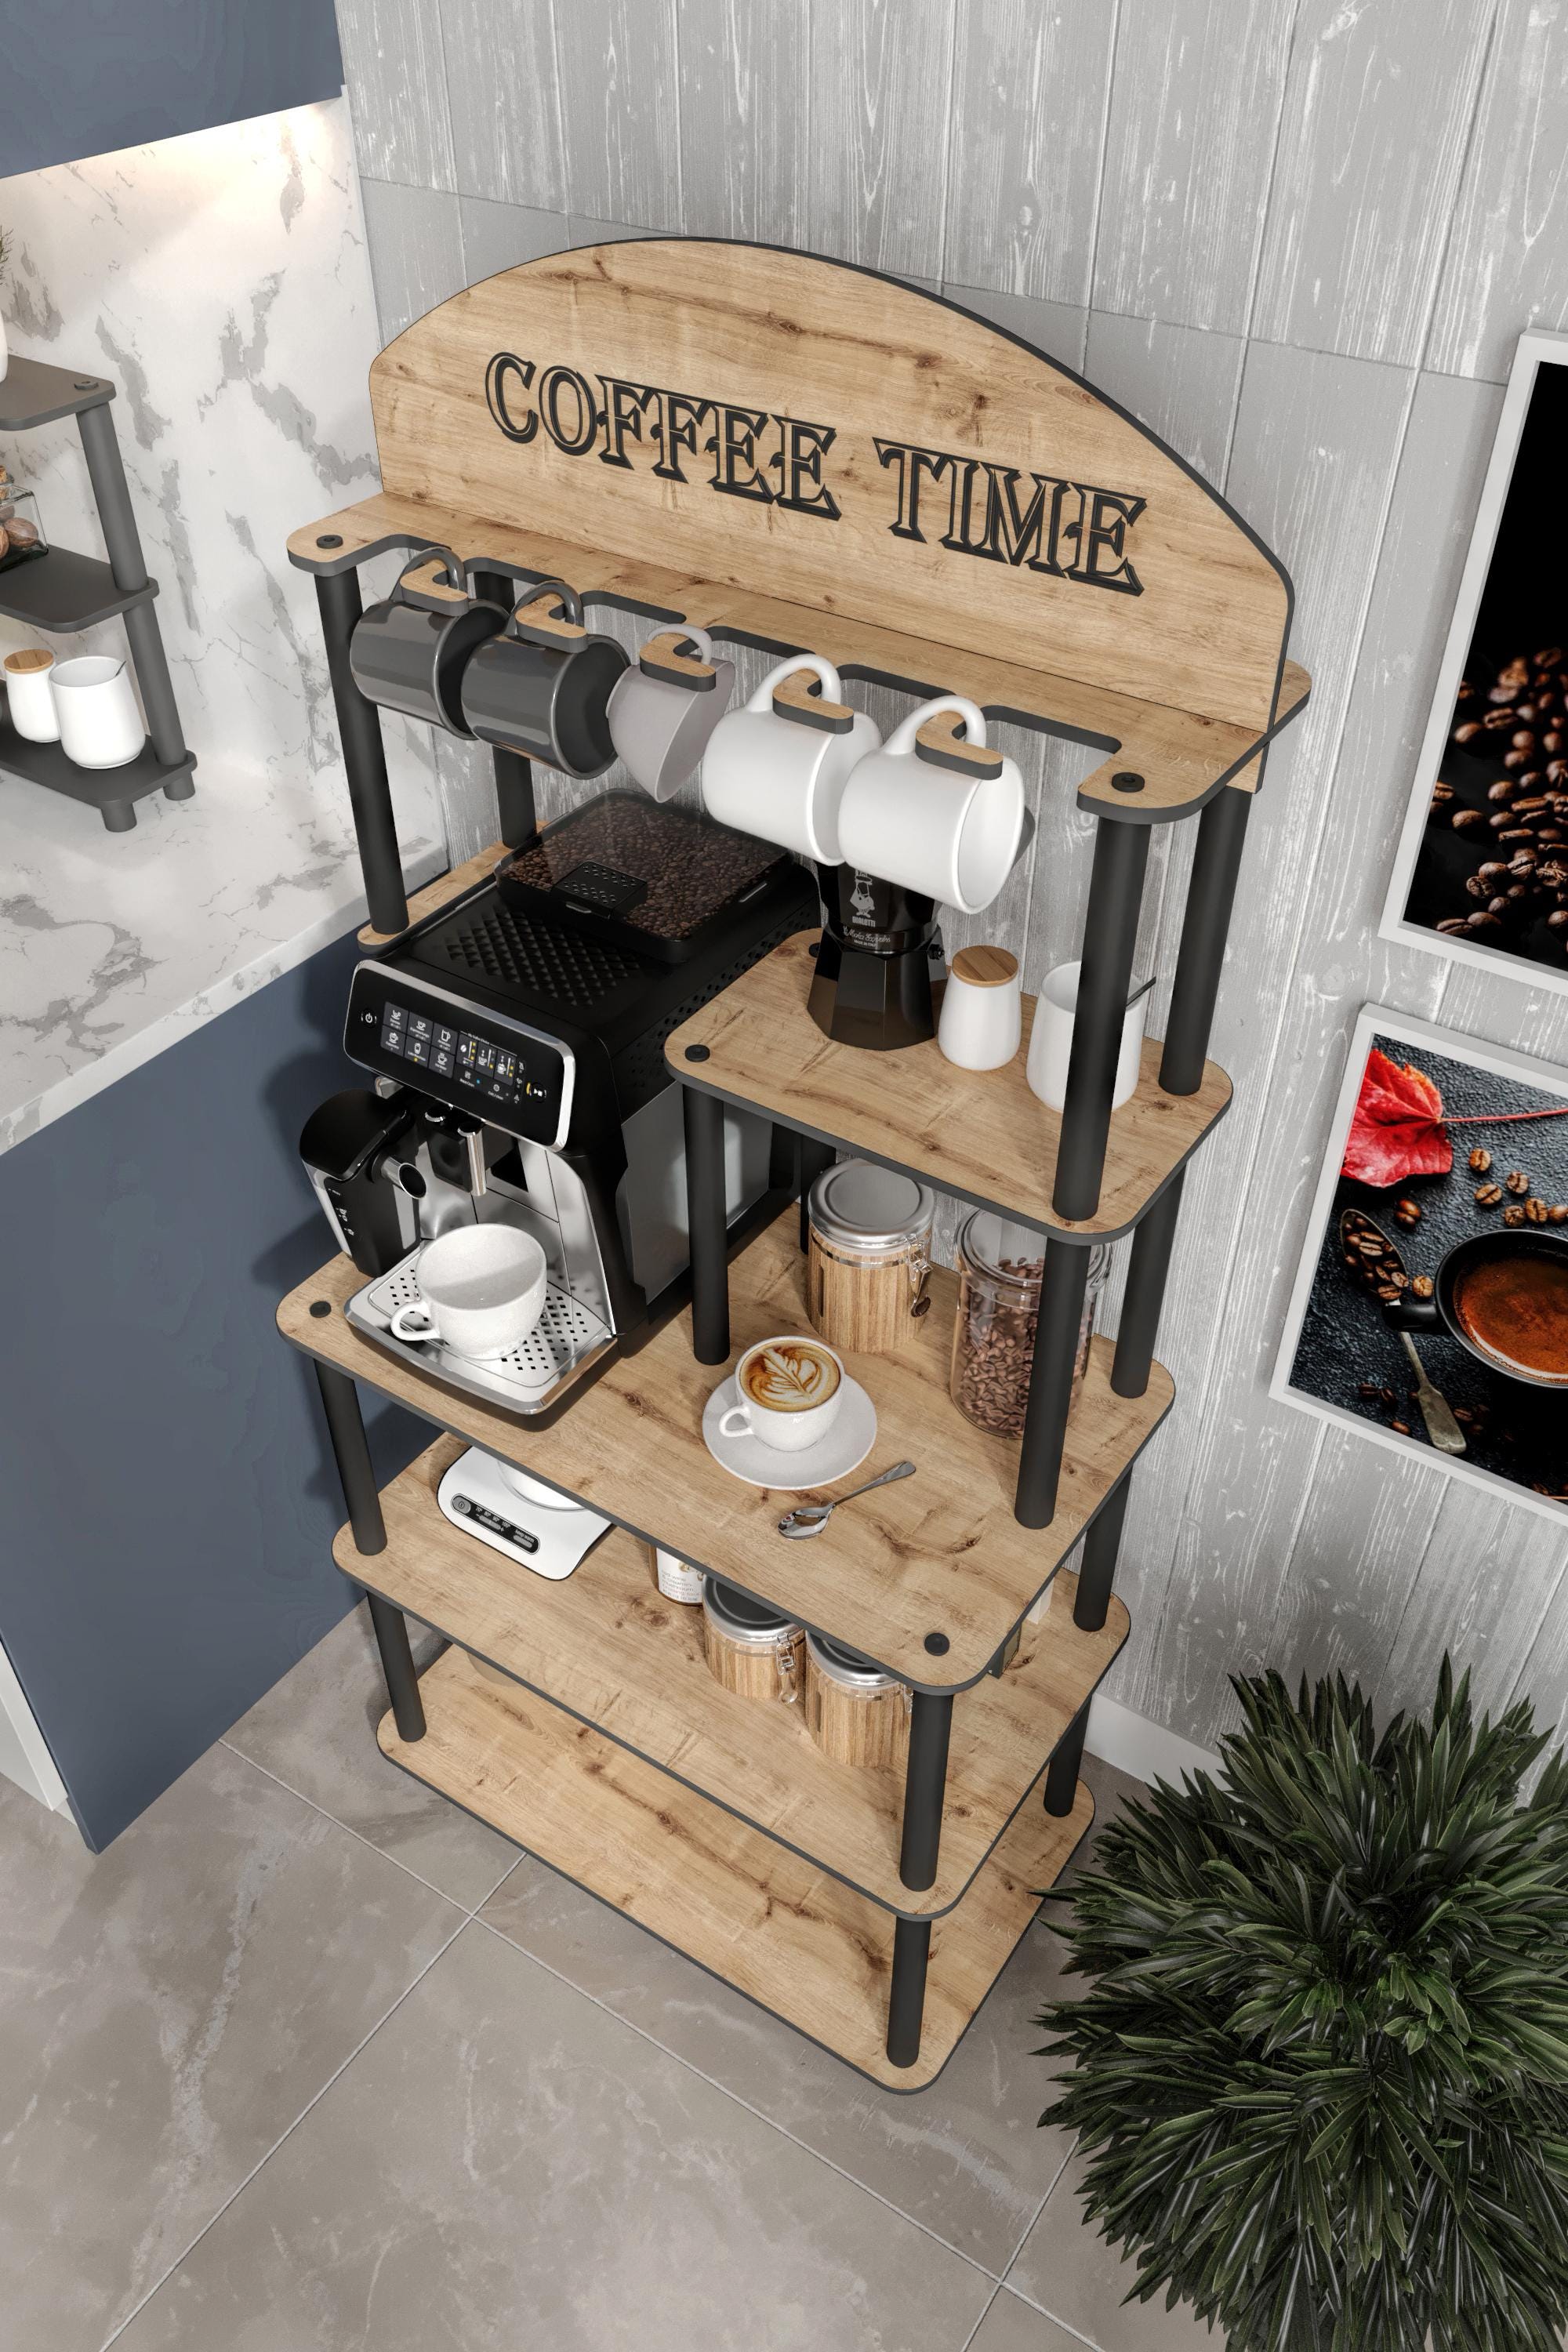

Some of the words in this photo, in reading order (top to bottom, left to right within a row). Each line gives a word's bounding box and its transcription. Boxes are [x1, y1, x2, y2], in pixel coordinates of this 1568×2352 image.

[485, 351, 842, 521] COFFEE
[872, 437, 1149, 597] TIME
[852, 916, 876, 927] BIALETTI
